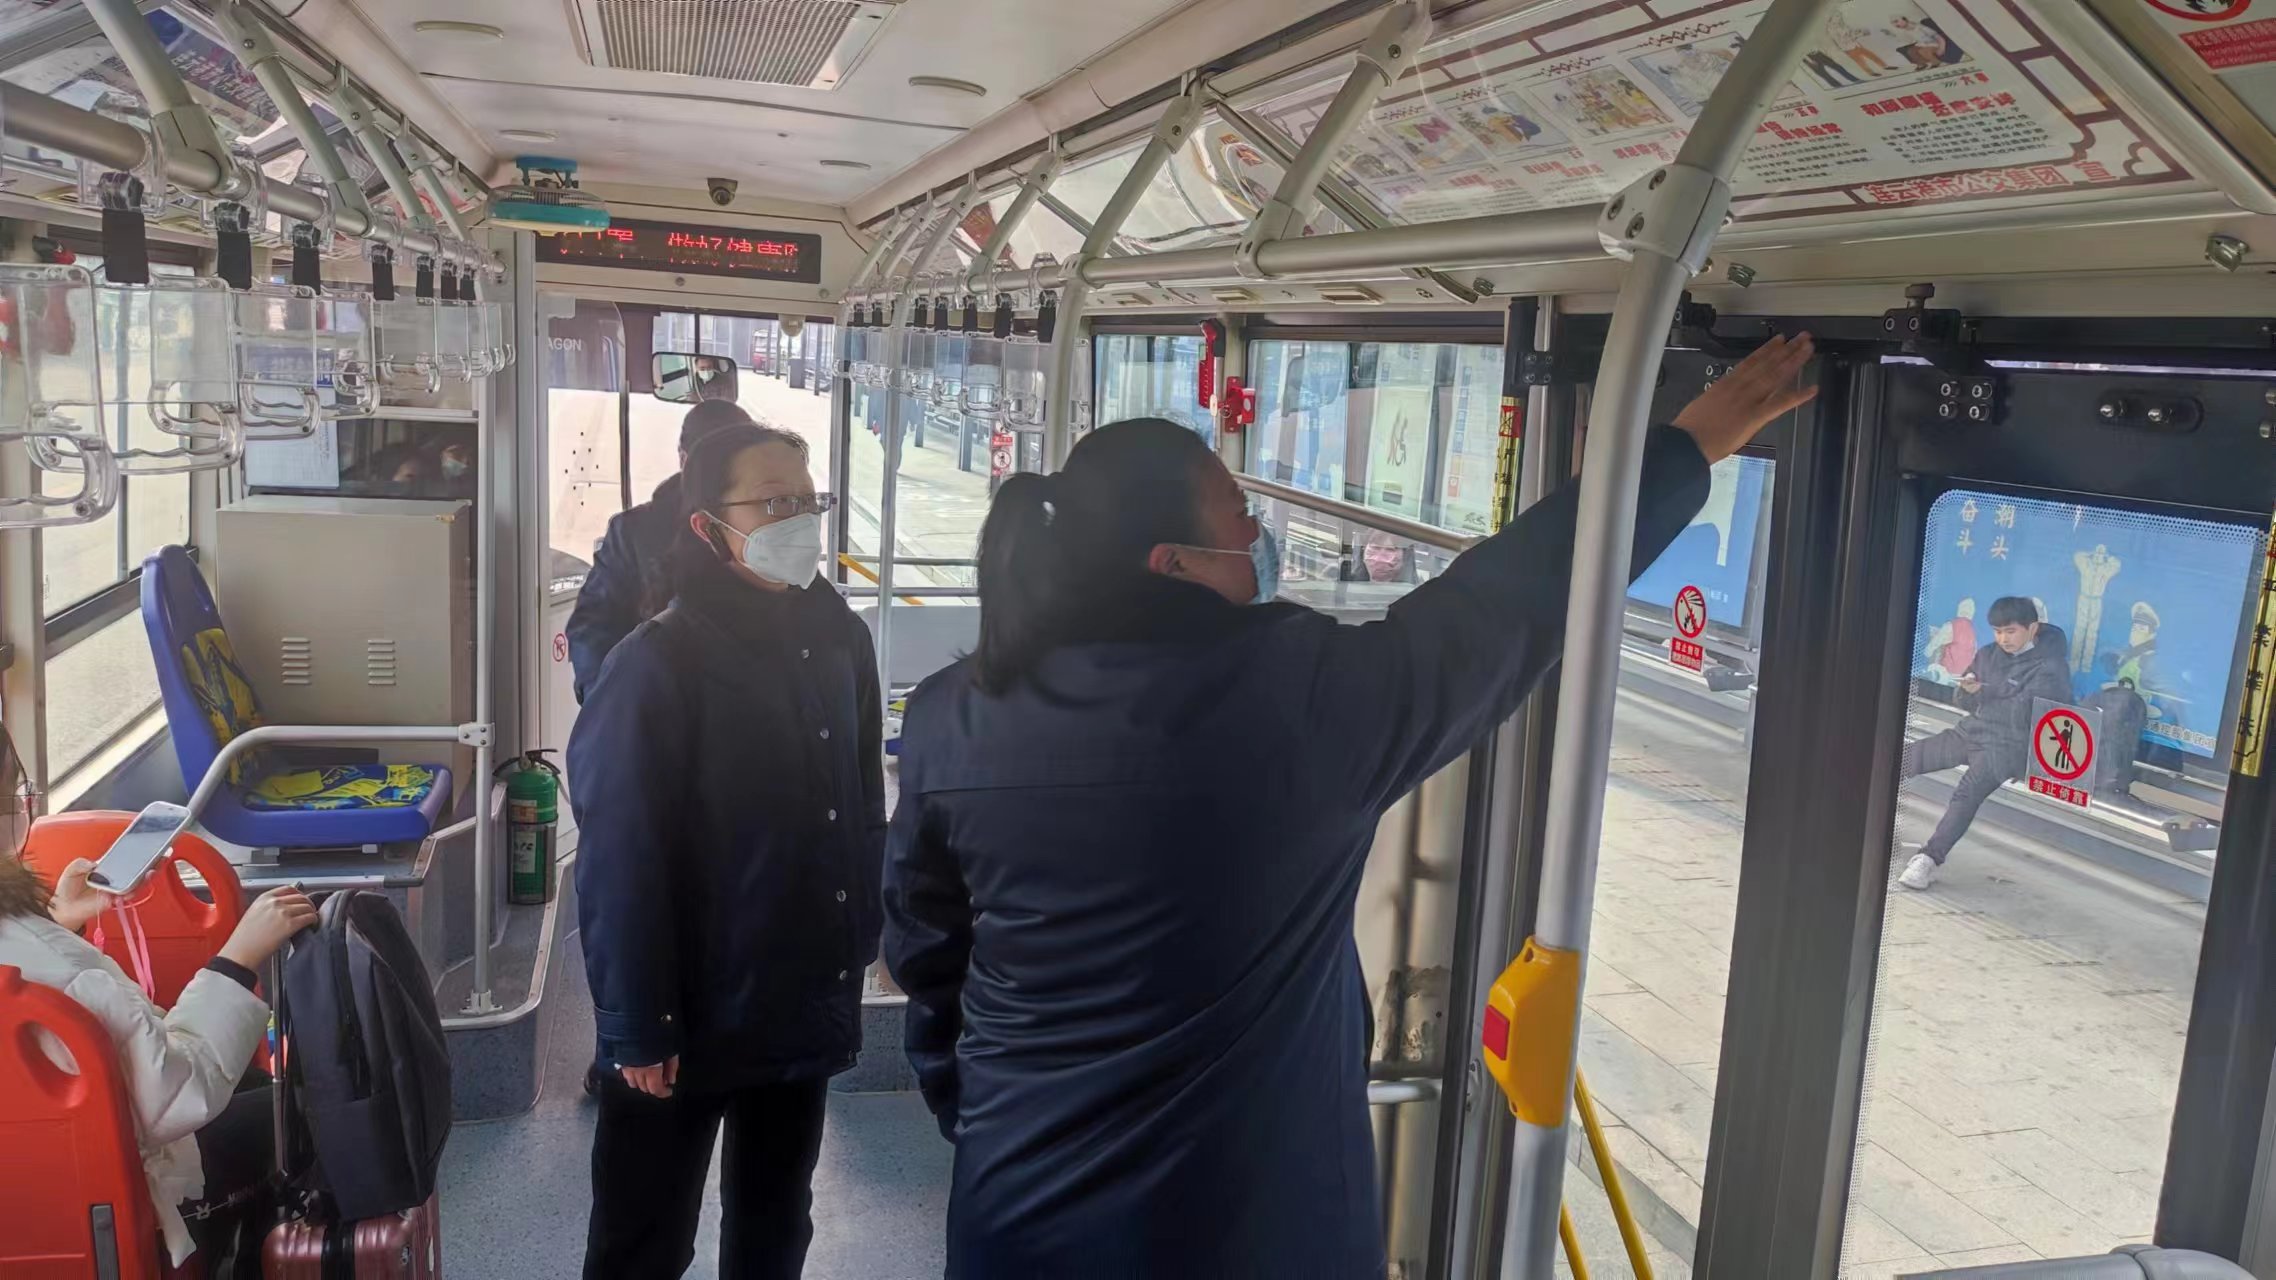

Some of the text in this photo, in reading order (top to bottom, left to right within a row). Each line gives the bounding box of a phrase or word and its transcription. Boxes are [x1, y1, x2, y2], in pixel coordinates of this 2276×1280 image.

[1866, 160, 2116, 204] 连云港市公交集团 宣
[2032, 779, 2084, 805] 禁止倚靠
